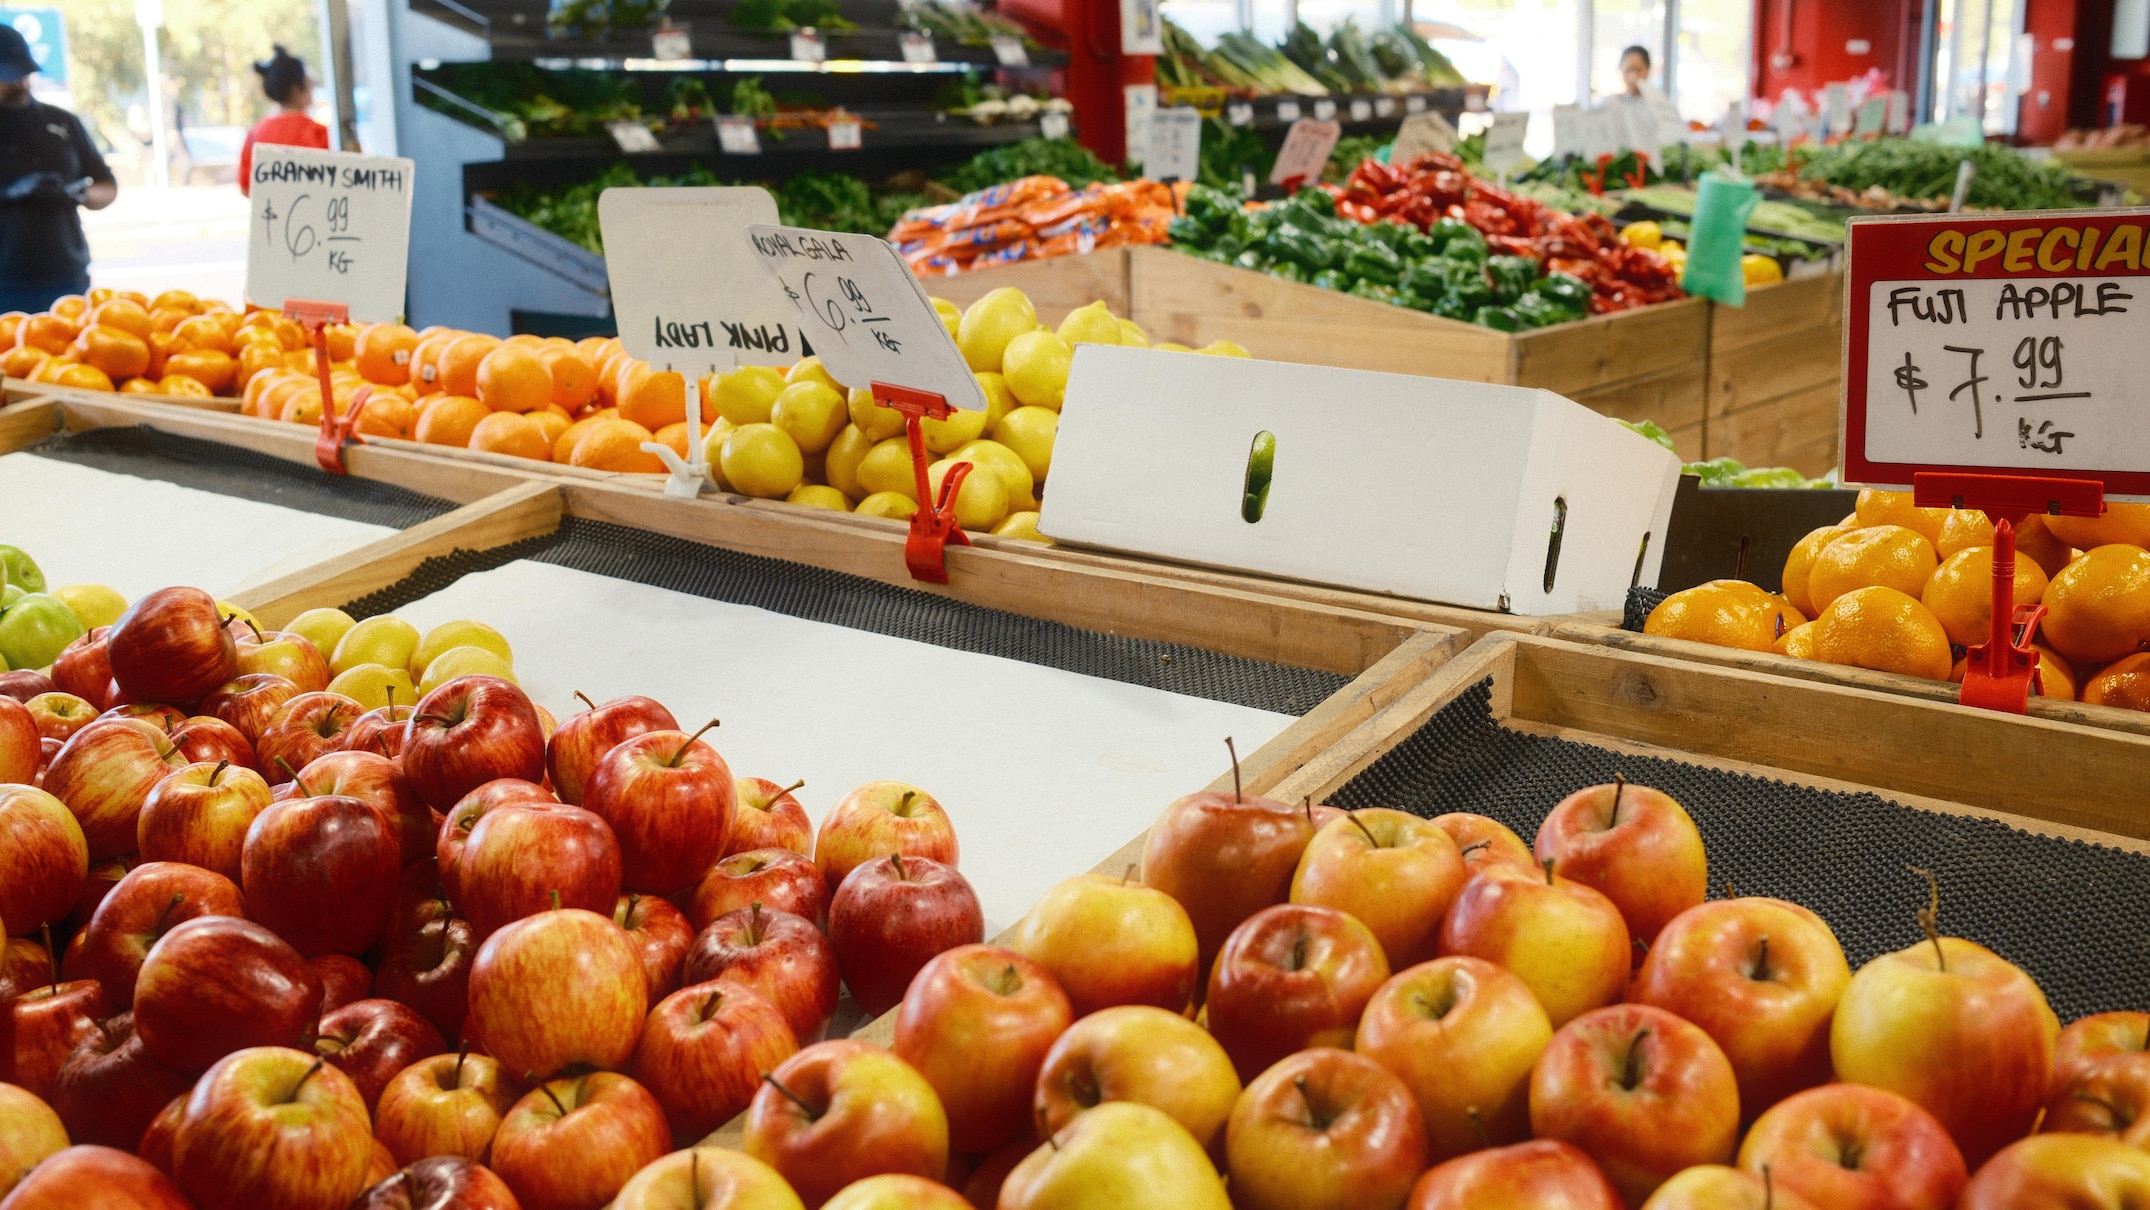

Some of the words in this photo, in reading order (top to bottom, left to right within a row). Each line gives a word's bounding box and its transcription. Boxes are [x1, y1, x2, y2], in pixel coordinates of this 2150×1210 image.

[255, 161, 337, 188] GRANNY
[342, 168, 402, 193] SMITH
[328, 250, 354, 273] KG
[751, 233, 800, 258] ROYAL
[798, 236, 854, 262] GALA
[1923, 223, 2150, 276] SPECIA
[1887, 285, 1969, 326] FUJI
[1996, 282, 2134, 320] APPLE
[655, 316, 714, 349] LADY
[720, 320, 789, 354] PINK
[870, 328, 902, 355] KG
[2018, 415, 2075, 455] KG
